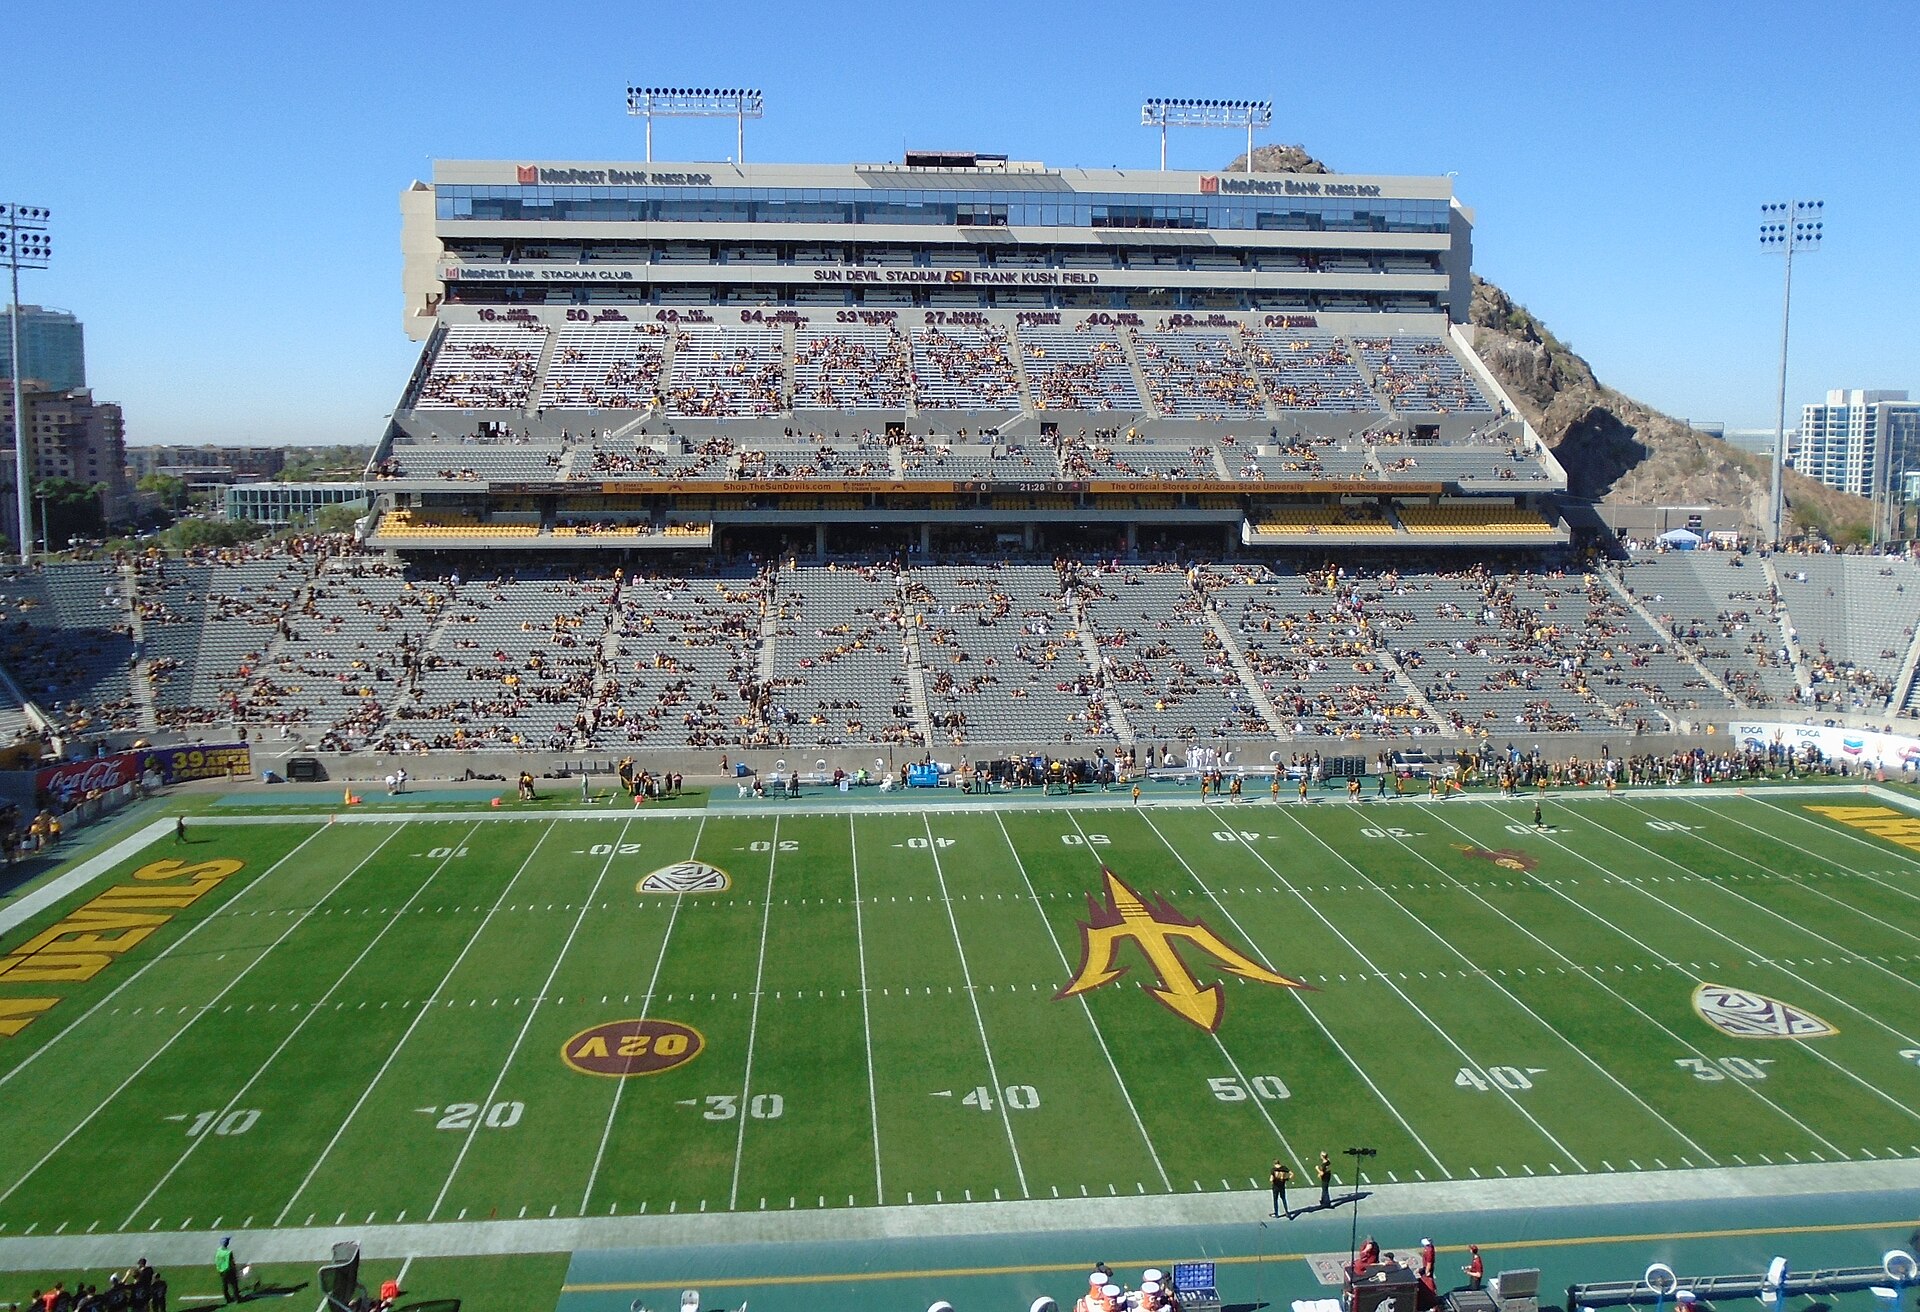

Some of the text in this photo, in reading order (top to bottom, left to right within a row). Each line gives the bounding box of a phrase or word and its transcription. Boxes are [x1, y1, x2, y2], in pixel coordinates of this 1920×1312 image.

[541, 270, 596, 280] STADIUM
[599, 270, 632, 280] CLUB
[813, 270, 840, 280] SUN
[846, 270, 882, 281] DEVIL
[886, 270, 941, 282] STADIUM
[973, 271, 1017, 283] FRANK
[1021, 272, 1058, 284] KUSH
[1062, 272, 1098, 284] FIELD
[477, 308, 496, 321] 16
[566, 309, 589, 321] 50
[656, 309, 677, 322] 42
[740, 310, 763, 323] 84
[836, 310, 858, 323] 33
[925, 311, 945, 324] 27
[1087, 312, 1110, 325] 40
[1173, 313, 1194, 326] 52
[723, 482, 831, 491] Shop.TheSunDevils.com
[980, 483, 987, 491] 0
[1020, 483, 1045, 491] 21:28
[1057, 483, 1063, 491] 0
[1111, 482, 1305, 492] The Official Stores of Arizona State University
[1740, 726, 1763, 734] TOCA
[1796, 728, 1820, 738] TOCA
[172, 751, 203, 769] 39
[1211, 830, 1260, 842] 40
[1360, 827, 1414, 838] 30
[908, 837, 956, 848] 40
[1061, 834, 1111, 845] 50
[589, 843, 641, 855] 20
[749, 840, 799, 852] 30
[427, 847, 469, 858] 10
[1674, 1057, 1767, 1081] 30
[1454, 1066, 1533, 1092] 40
[1206, 1075, 1291, 1101] 50
[962, 1085, 1040, 1111] 40
[703, 1093, 784, 1120] 30
[436, 1102, 525, 1129] 20
[185, 1109, 261, 1136] 10
